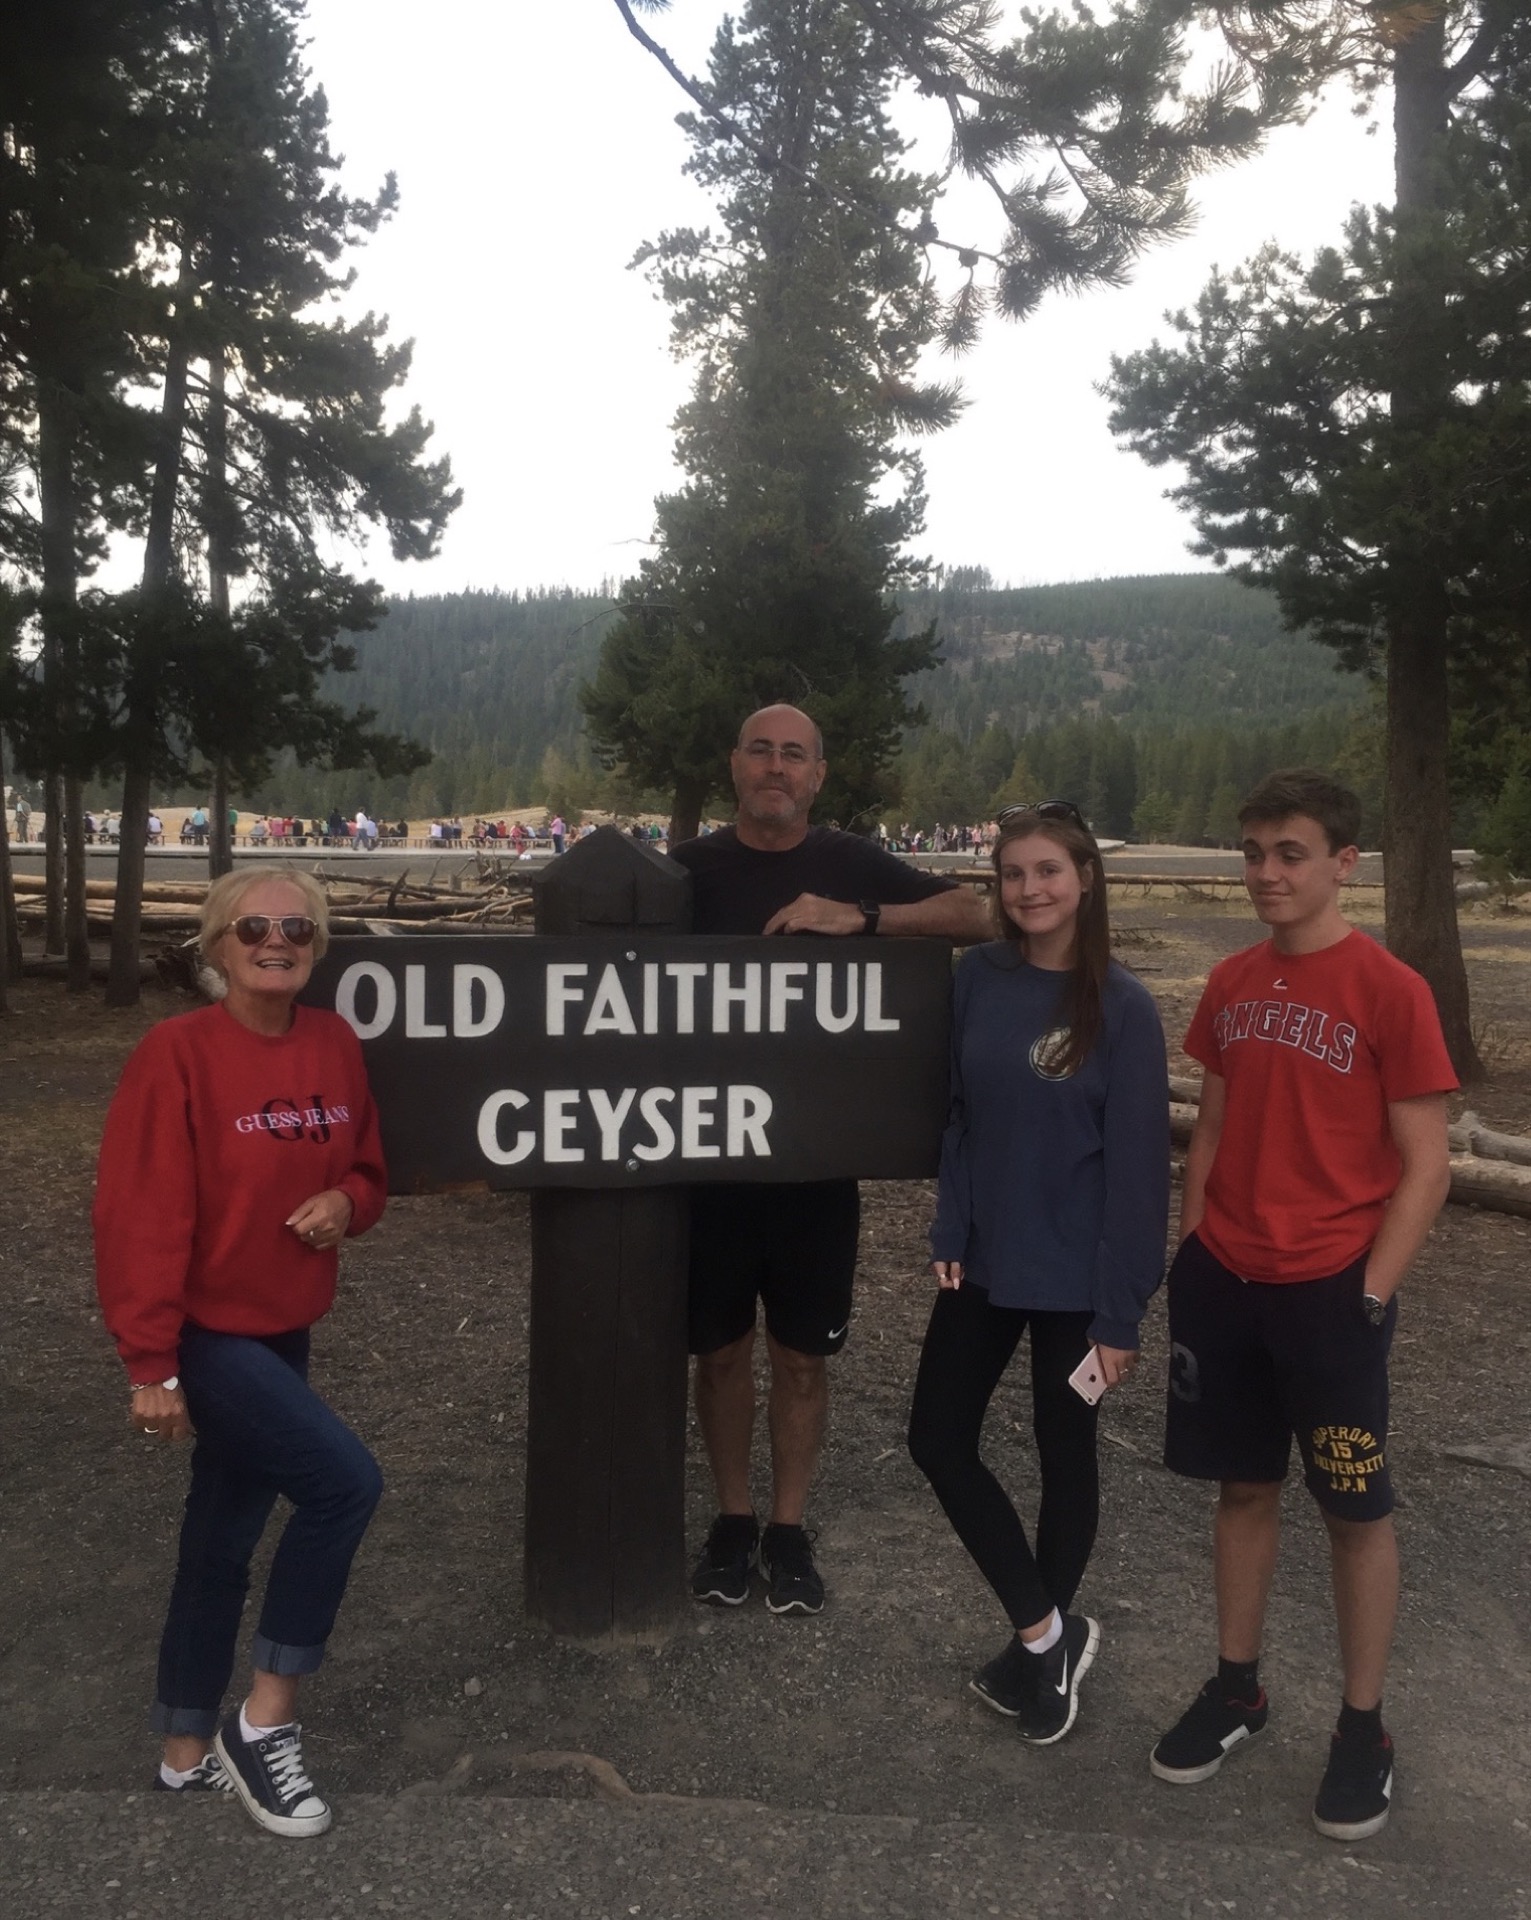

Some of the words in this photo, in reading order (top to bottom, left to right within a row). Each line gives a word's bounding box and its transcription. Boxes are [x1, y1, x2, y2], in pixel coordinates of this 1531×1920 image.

[334, 960, 506, 1040] OLD
[545, 962, 901, 1036] FAITHFUL
[1214, 1000, 1357, 1074] ANGELS
[235, 1111, 302, 1133] GUESS
[305, 1106, 350, 1127] JEANS
[476, 1085, 774, 1166] GEYSER
[1329, 1441, 1352, 1458] 15
